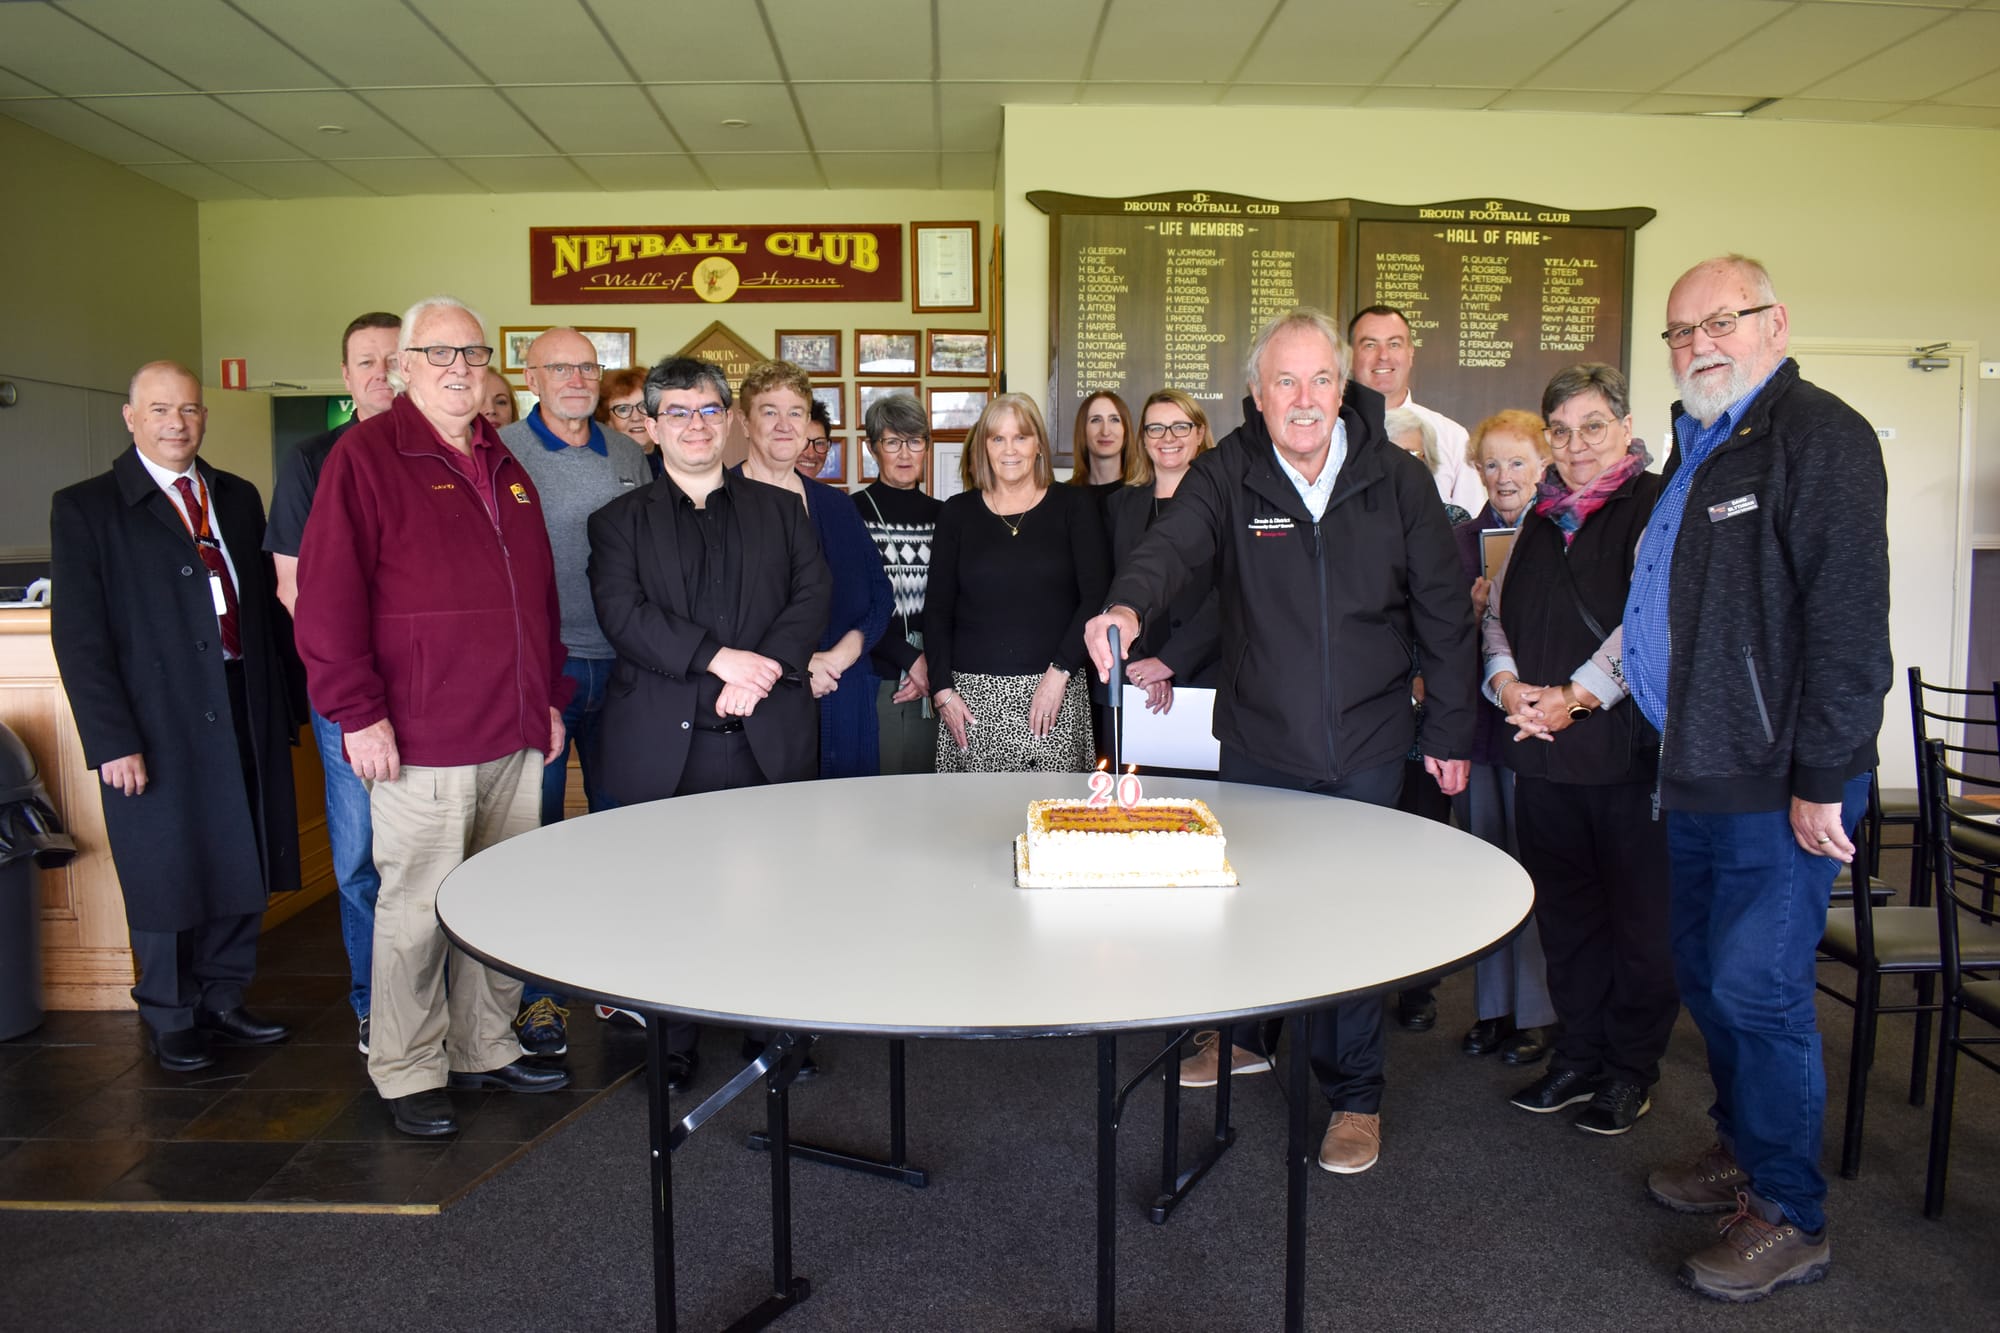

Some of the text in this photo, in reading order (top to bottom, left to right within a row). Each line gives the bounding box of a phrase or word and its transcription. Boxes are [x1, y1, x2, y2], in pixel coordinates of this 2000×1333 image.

[1124, 202, 1280, 214] DROUIN FOOTBALL CLUB
[1420, 209, 1570, 223] DROUIN FOOTBALL CLUB
[1160, 222, 1244, 236] LIFE MEMBERS
[1447, 229, 1540, 245] HALL OF FAME
[552, 232, 879, 279] NETBALL CLUB
[1087, 256, 1106, 264] RICE
[1176, 258, 1225, 266] CARTWRIGHT
[1471, 256, 1509, 264] QUIGLEY
[1175, 267, 1207, 275] HUGHES
[1260, 269, 1292, 277] HUGHES
[1472, 265, 1507, 274] ROGERS
[1551, 268, 1577, 276] STEER
[591, 272, 661, 287] Wall
[743, 272, 836, 287] Honour
[1087, 275, 1124, 283] QUIGLEY
[1471, 275, 1512, 284] PETERSEN
[1087, 285, 1128, 293] GOODWIN
[1174, 286, 1207, 294] ROGERS
[1385, 282, 1418, 290] BAXTER
[1470, 284, 1502, 292] LEESON
[1260, 288, 1294, 296] WHELLER
[1385, 291, 1429, 300] PEPPERELL
[1087, 294, 1115, 302] BACON
[1259, 298, 1299, 306] PETERSEN
[1471, 294, 1501, 302] AITKEN
[1551, 296, 1600, 304] DONALDSON
[1174, 306, 1204, 314] LEESON
[1566, 305, 1596, 314] ABLETT
[1469, 312, 1509, 321] TROLLOPE
[1565, 315, 1595, 323] ABLETT
[1175, 324, 1206, 332] FORBES
[1470, 322, 1499, 330] BUDGE
[1565, 324, 1595, 332] ABLETT
[1175, 334, 1225, 342] LOCKWOOD
[1470, 331, 1495, 339] PRATT
[1564, 334, 1595, 342] ABLETT
[1086, 342, 1127, 350] NOTTAGE
[1468, 340, 1513, 349] FERGUSON
[1550, 343, 1584, 351] THOMAS
[702, 350, 734, 361] DROUIN
[1467, 350, 1511, 358] SUCKLING
[1467, 359, 1506, 367] EDWARDS
[1175, 372, 1208, 380] JARRED
[1087, 771, 1143, 808] 20
